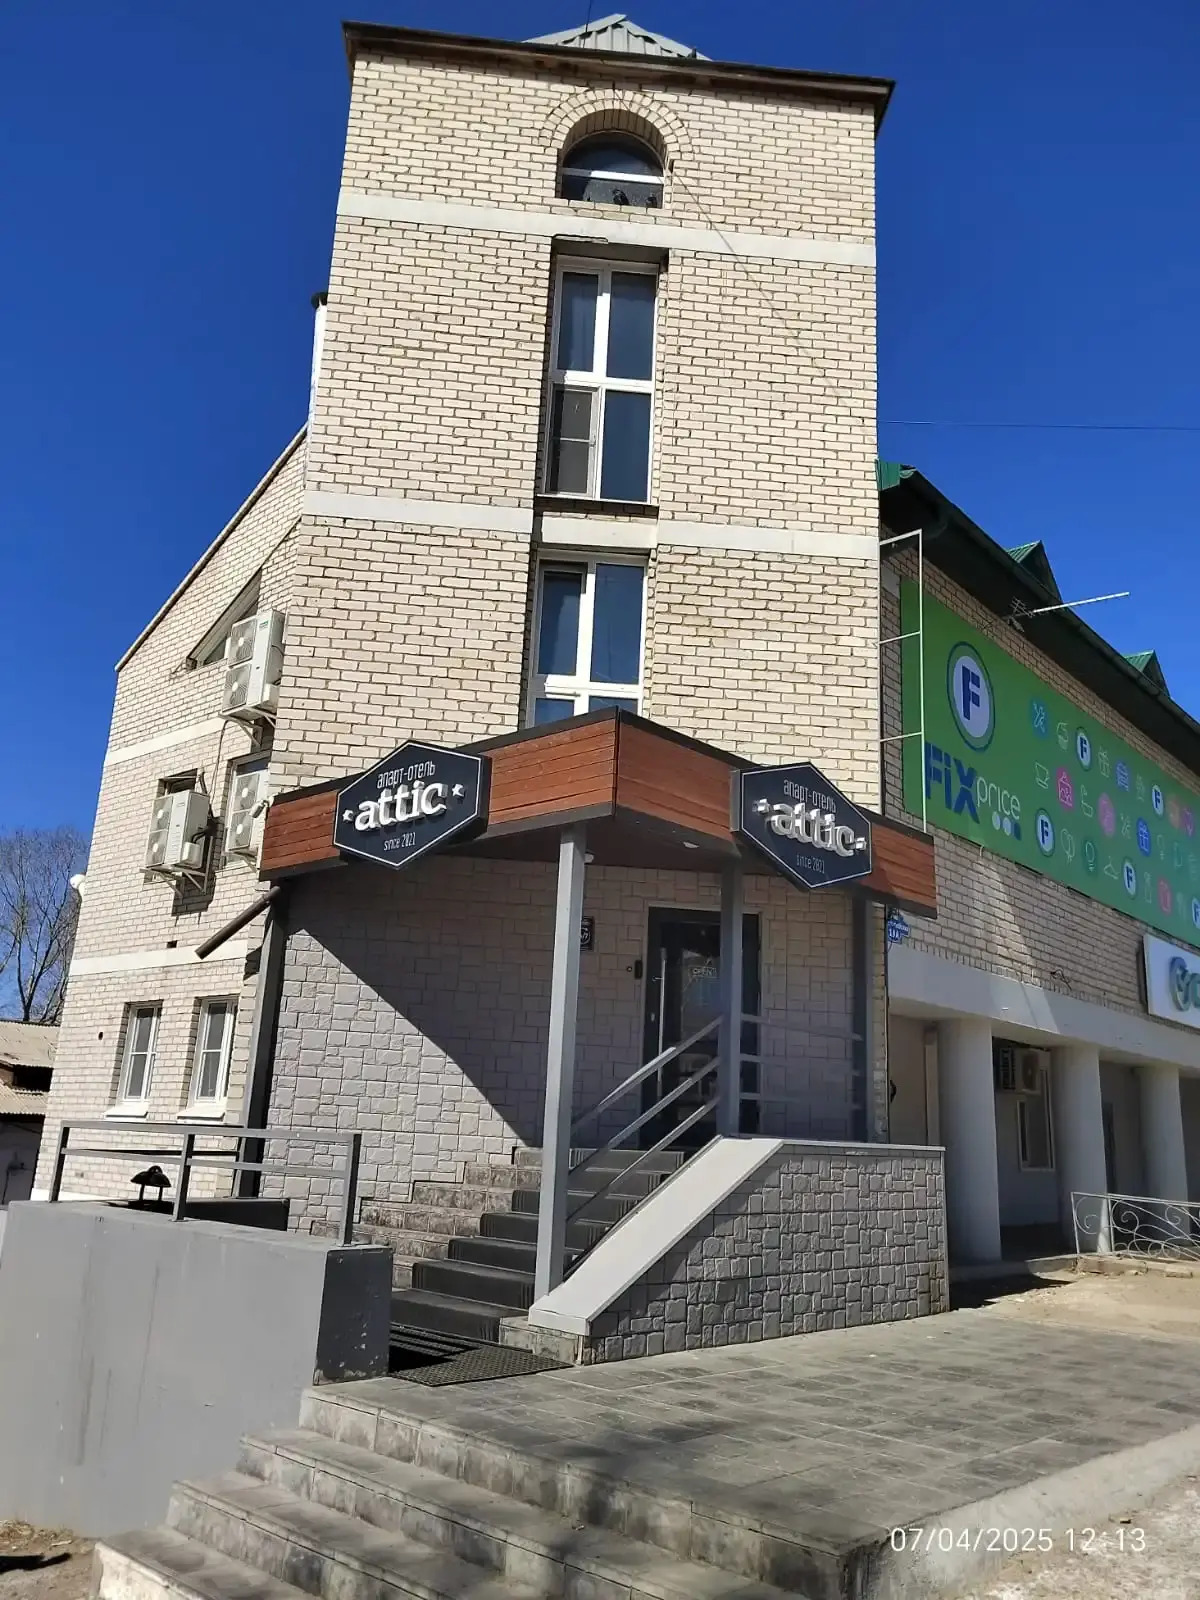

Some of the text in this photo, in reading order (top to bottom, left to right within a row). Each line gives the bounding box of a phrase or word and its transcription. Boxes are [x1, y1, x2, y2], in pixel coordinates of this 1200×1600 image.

[377, 761, 436, 789] апарт-отель
[355, 780, 448, 831] attic
[783, 779, 836, 813] апарт-отель
[976, 777, 1021, 820] price
[384, 835, 400, 851] since
[770, 802, 855, 857] attic
